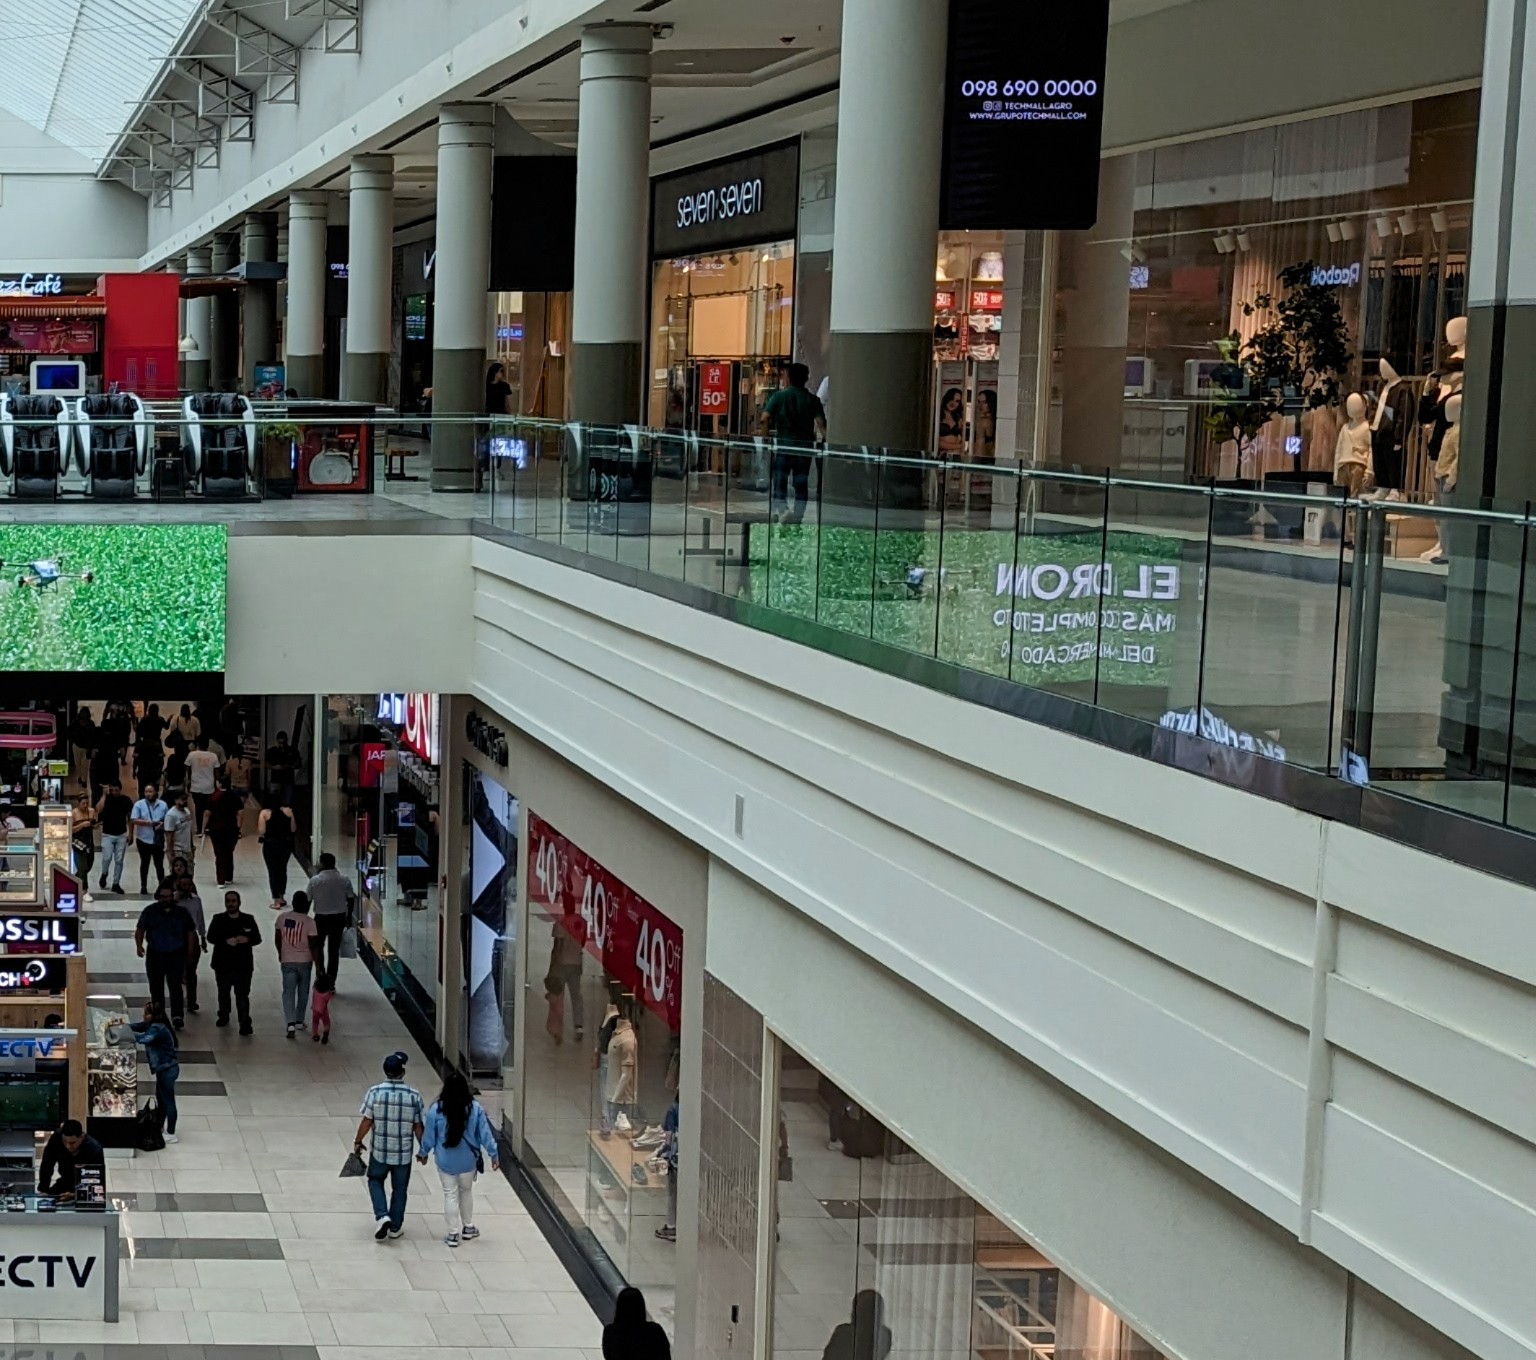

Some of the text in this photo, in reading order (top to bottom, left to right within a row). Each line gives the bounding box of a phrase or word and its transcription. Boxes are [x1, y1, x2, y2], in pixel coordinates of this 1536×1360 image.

[962, 80, 1097, 96] 098 690 0000
[20, 273, 62, 294] Café
[536, 835, 558, 905] 40
[580, 874, 607, 950] 40
[636, 919, 681, 1002] 40 Off
